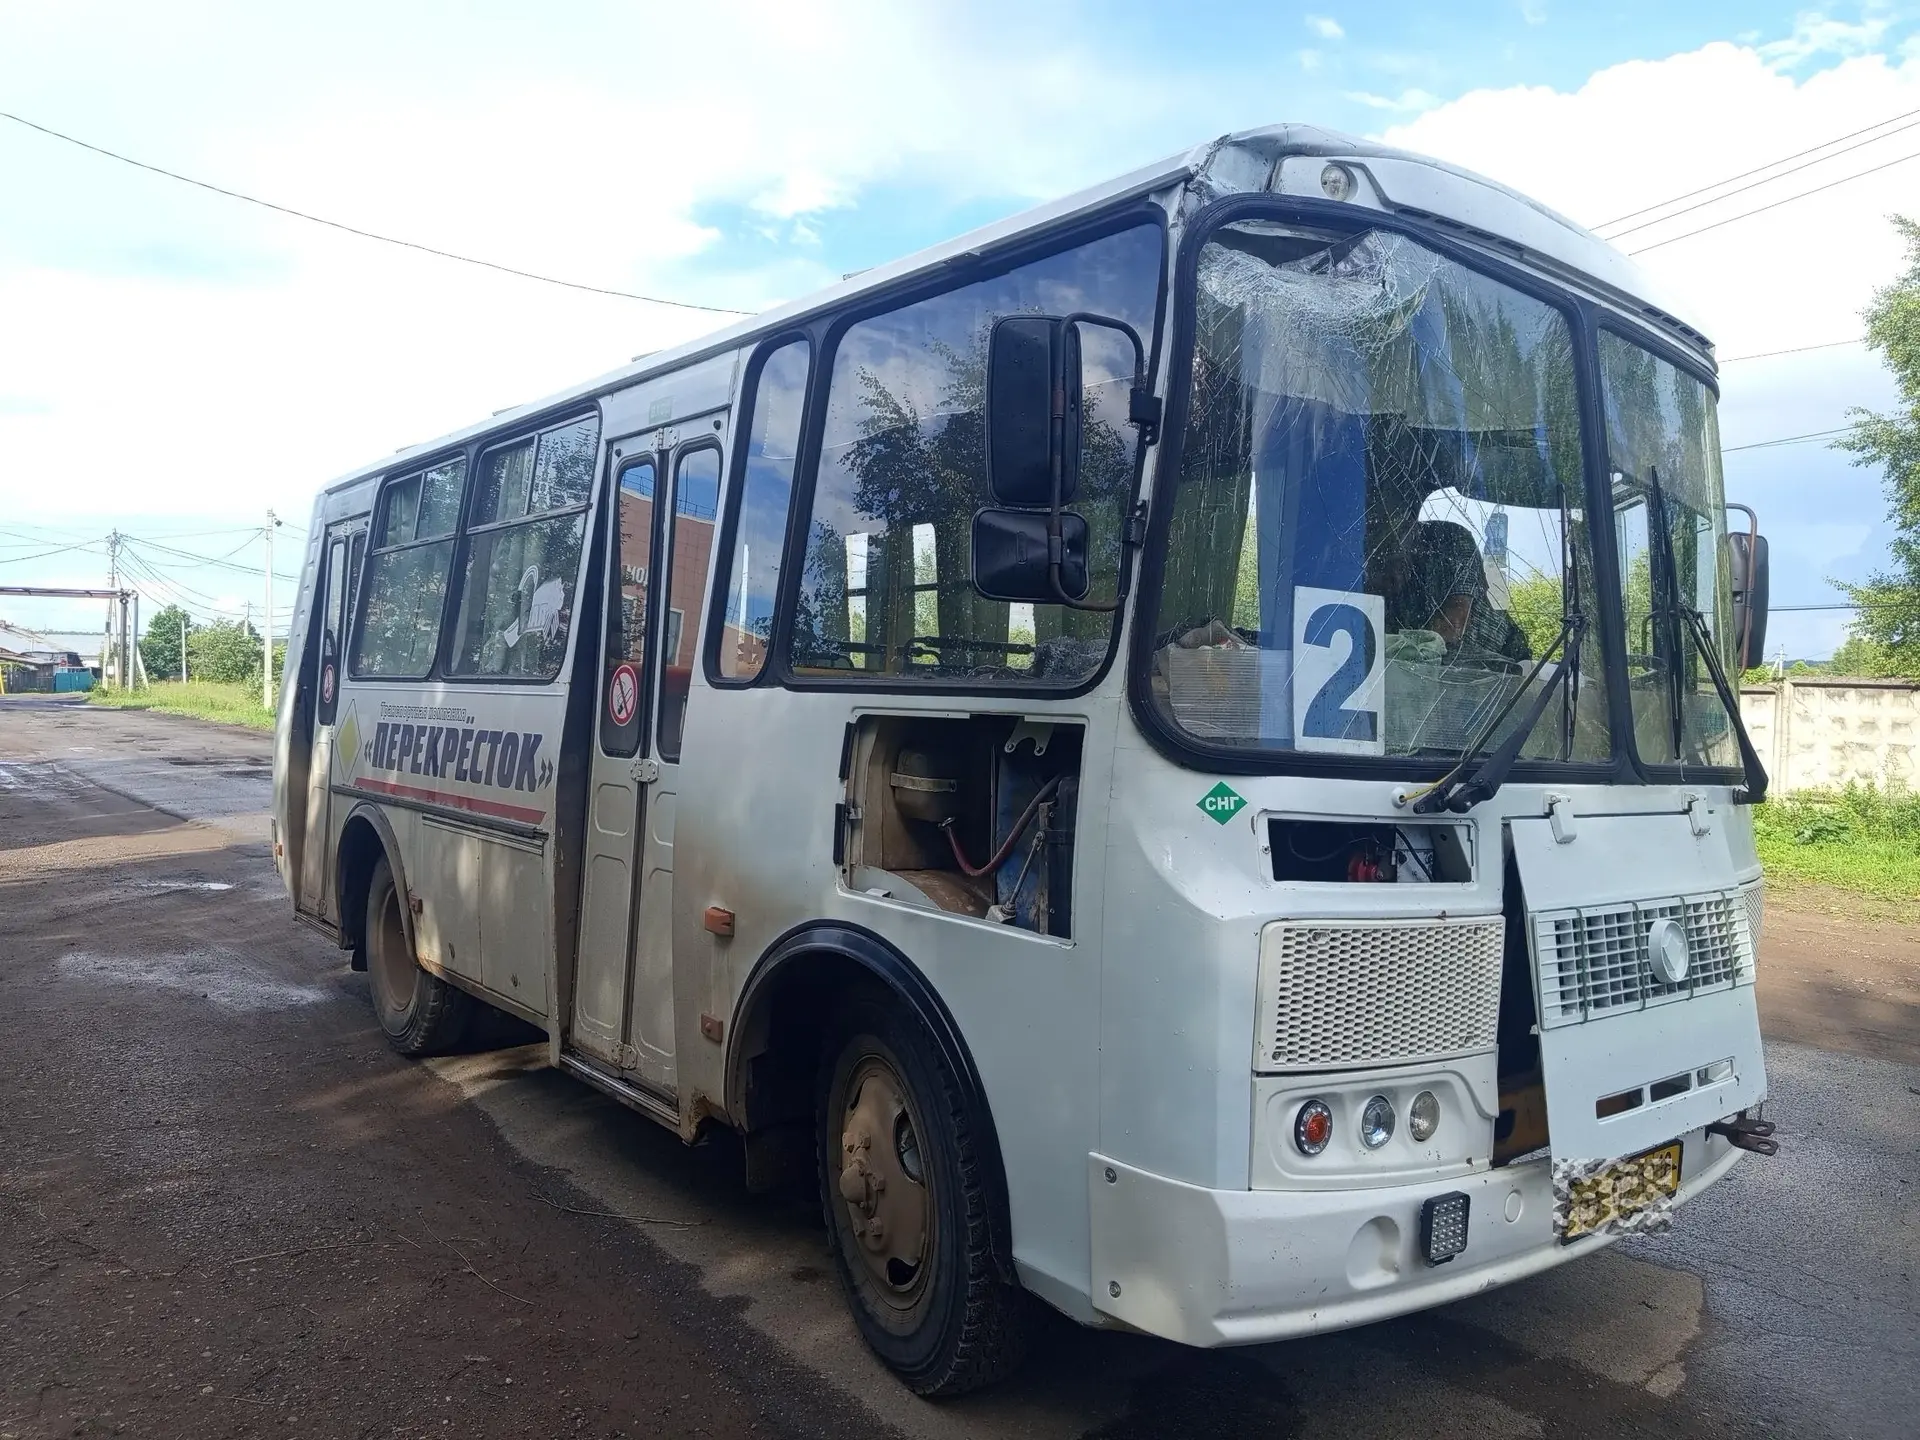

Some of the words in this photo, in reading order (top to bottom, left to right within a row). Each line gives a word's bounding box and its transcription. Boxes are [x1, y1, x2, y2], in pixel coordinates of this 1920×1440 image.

[1302, 603, 1378, 742] 2
[364, 715, 554, 793] «ПЕРЕКРЁСТОК»
[1204, 796, 1240, 812] СНГ
